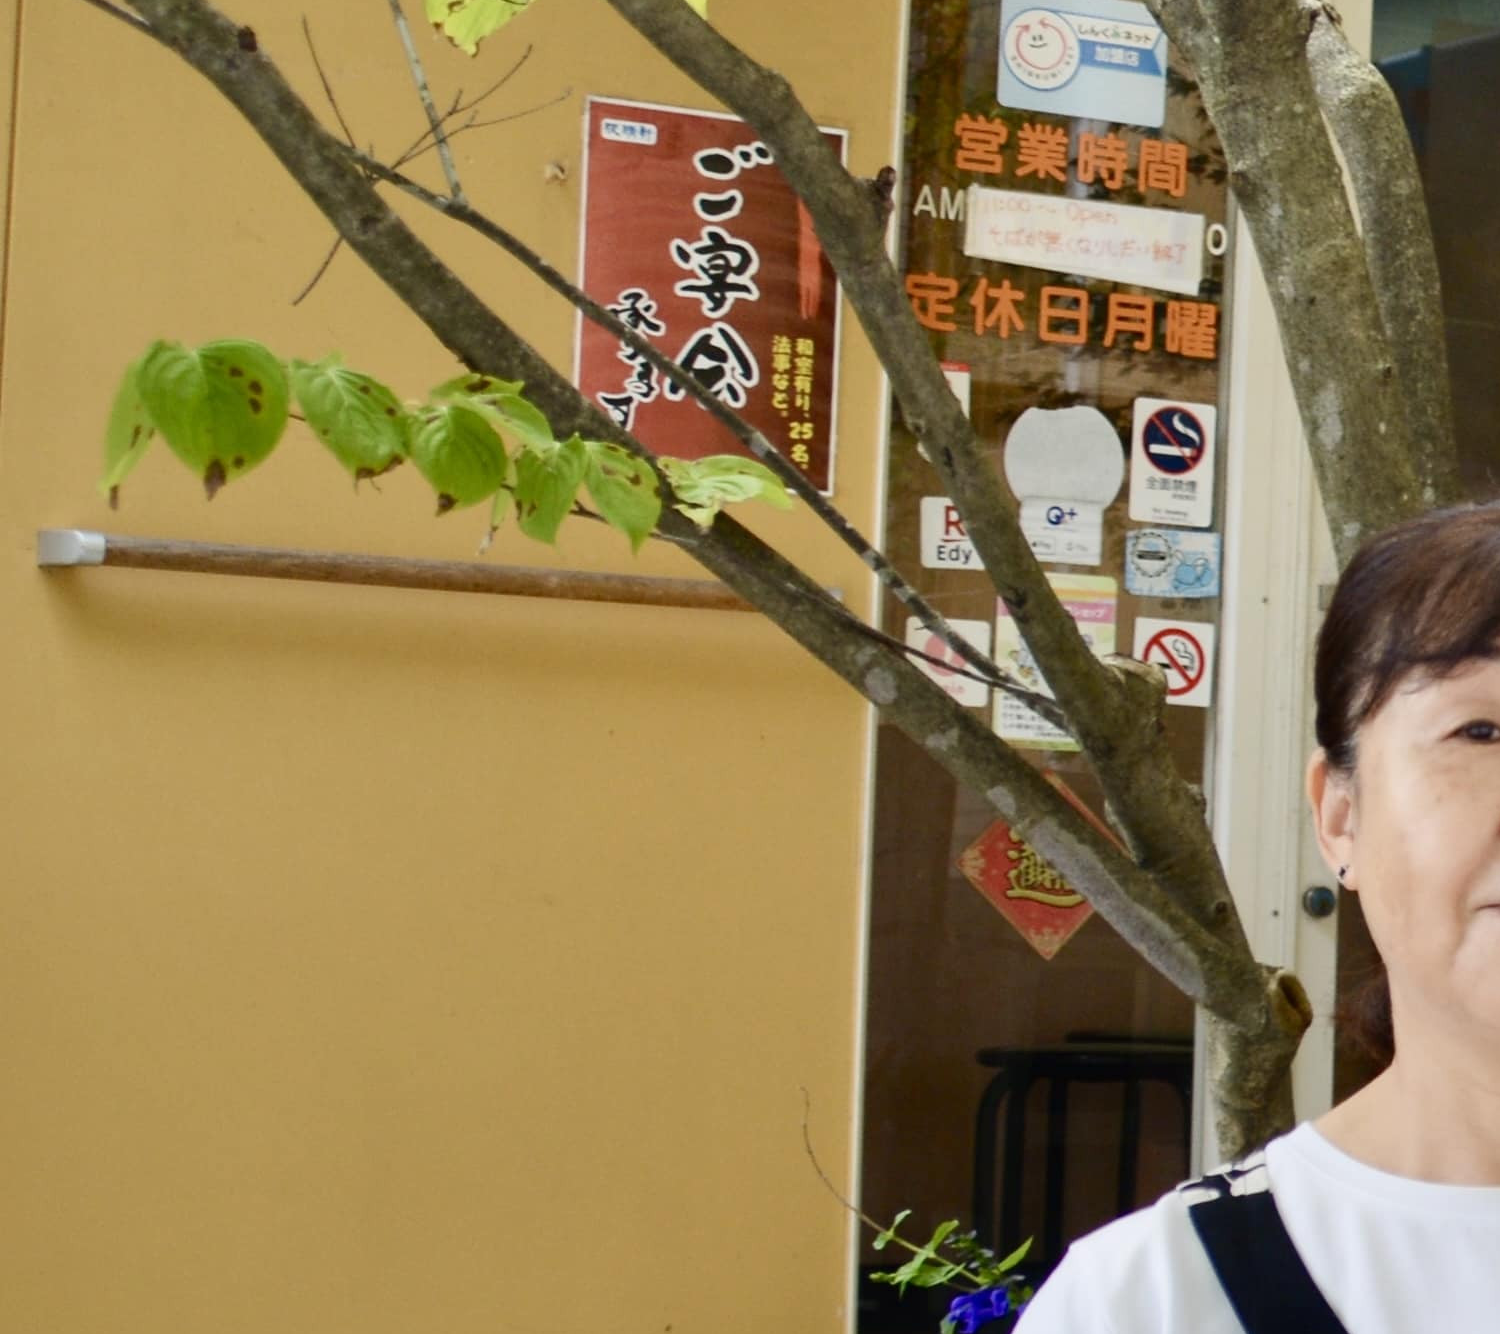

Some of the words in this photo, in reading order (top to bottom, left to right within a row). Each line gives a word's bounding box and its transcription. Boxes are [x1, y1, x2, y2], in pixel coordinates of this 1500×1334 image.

[954, 113, 1188, 198] 営業時間
[913, 184, 965, 222] AM
[905, 271, 1218, 360] 定休日月曜
[937, 544, 973, 564] Edy
